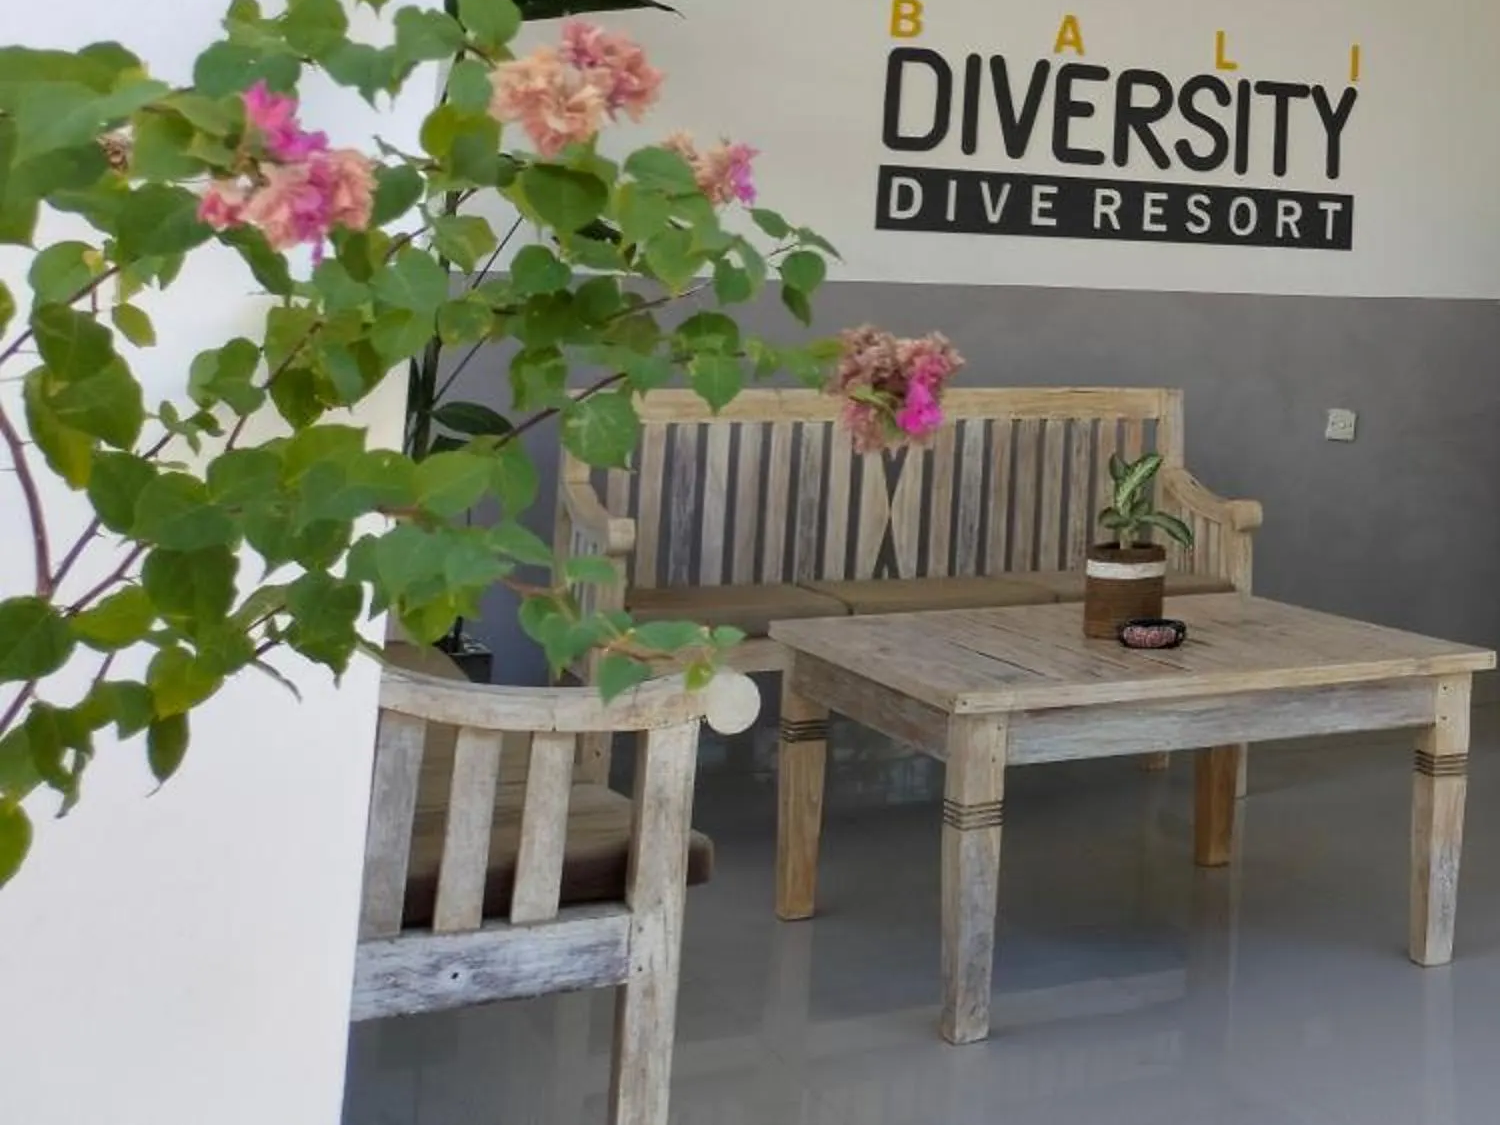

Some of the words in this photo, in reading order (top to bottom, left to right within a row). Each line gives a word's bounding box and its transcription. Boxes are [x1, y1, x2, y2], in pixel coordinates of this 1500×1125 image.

[882, 47, 1358, 179] DIVERSITY
[889, 177, 1058, 226] DIVE
[1093, 188, 1343, 240] RESORT
